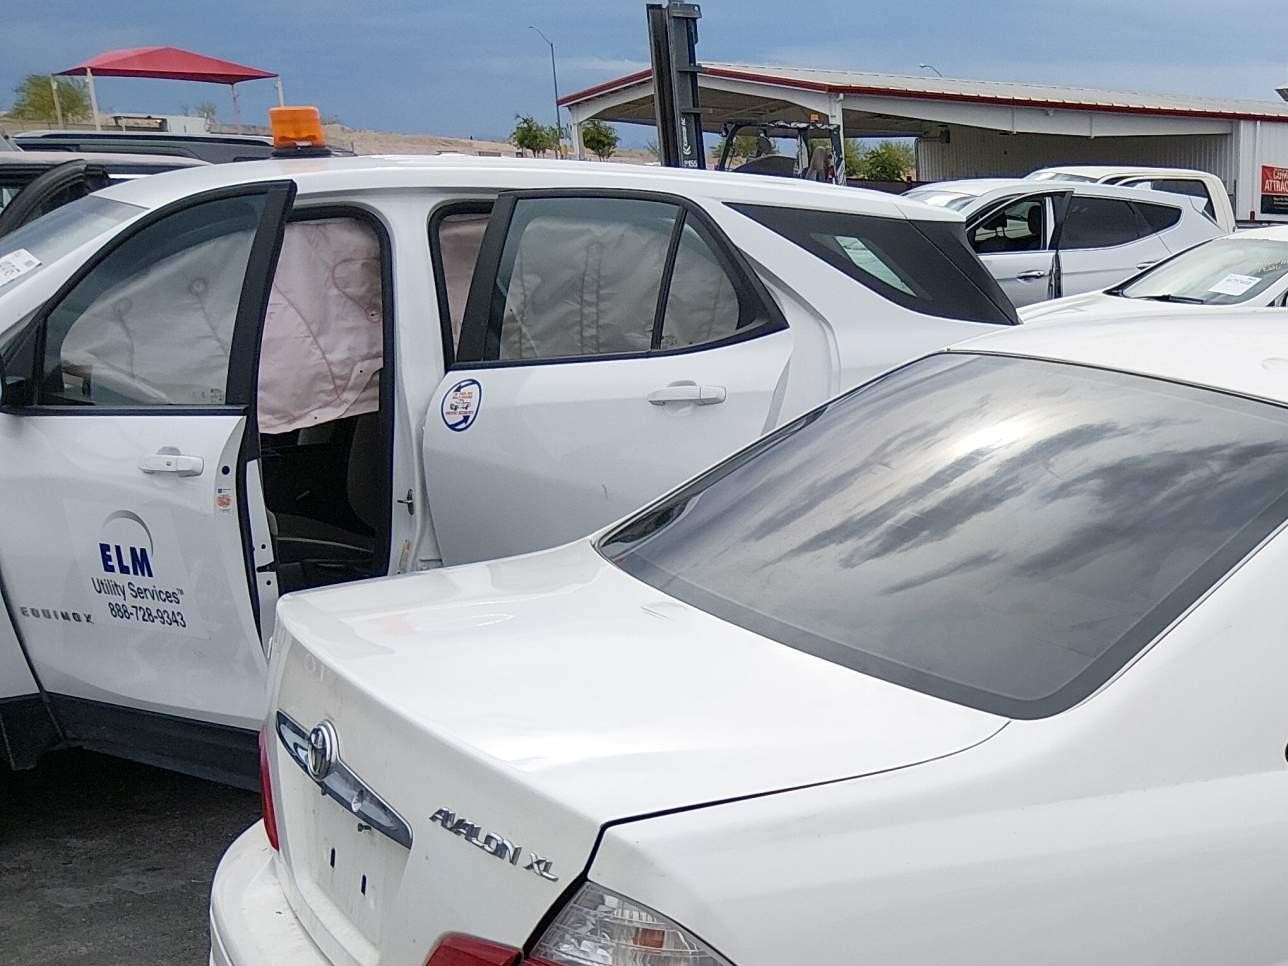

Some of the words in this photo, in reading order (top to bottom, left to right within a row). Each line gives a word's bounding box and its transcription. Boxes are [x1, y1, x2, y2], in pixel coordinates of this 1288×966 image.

[99, 543, 153, 577] ELM
[91, 577, 127, 601] Utility
[20, 606, 95, 624] EQUINOX
[108, 602, 186, 628] 888-728-9343
[429, 807, 522, 866] AVALON
[523, 852, 559, 882] XL
